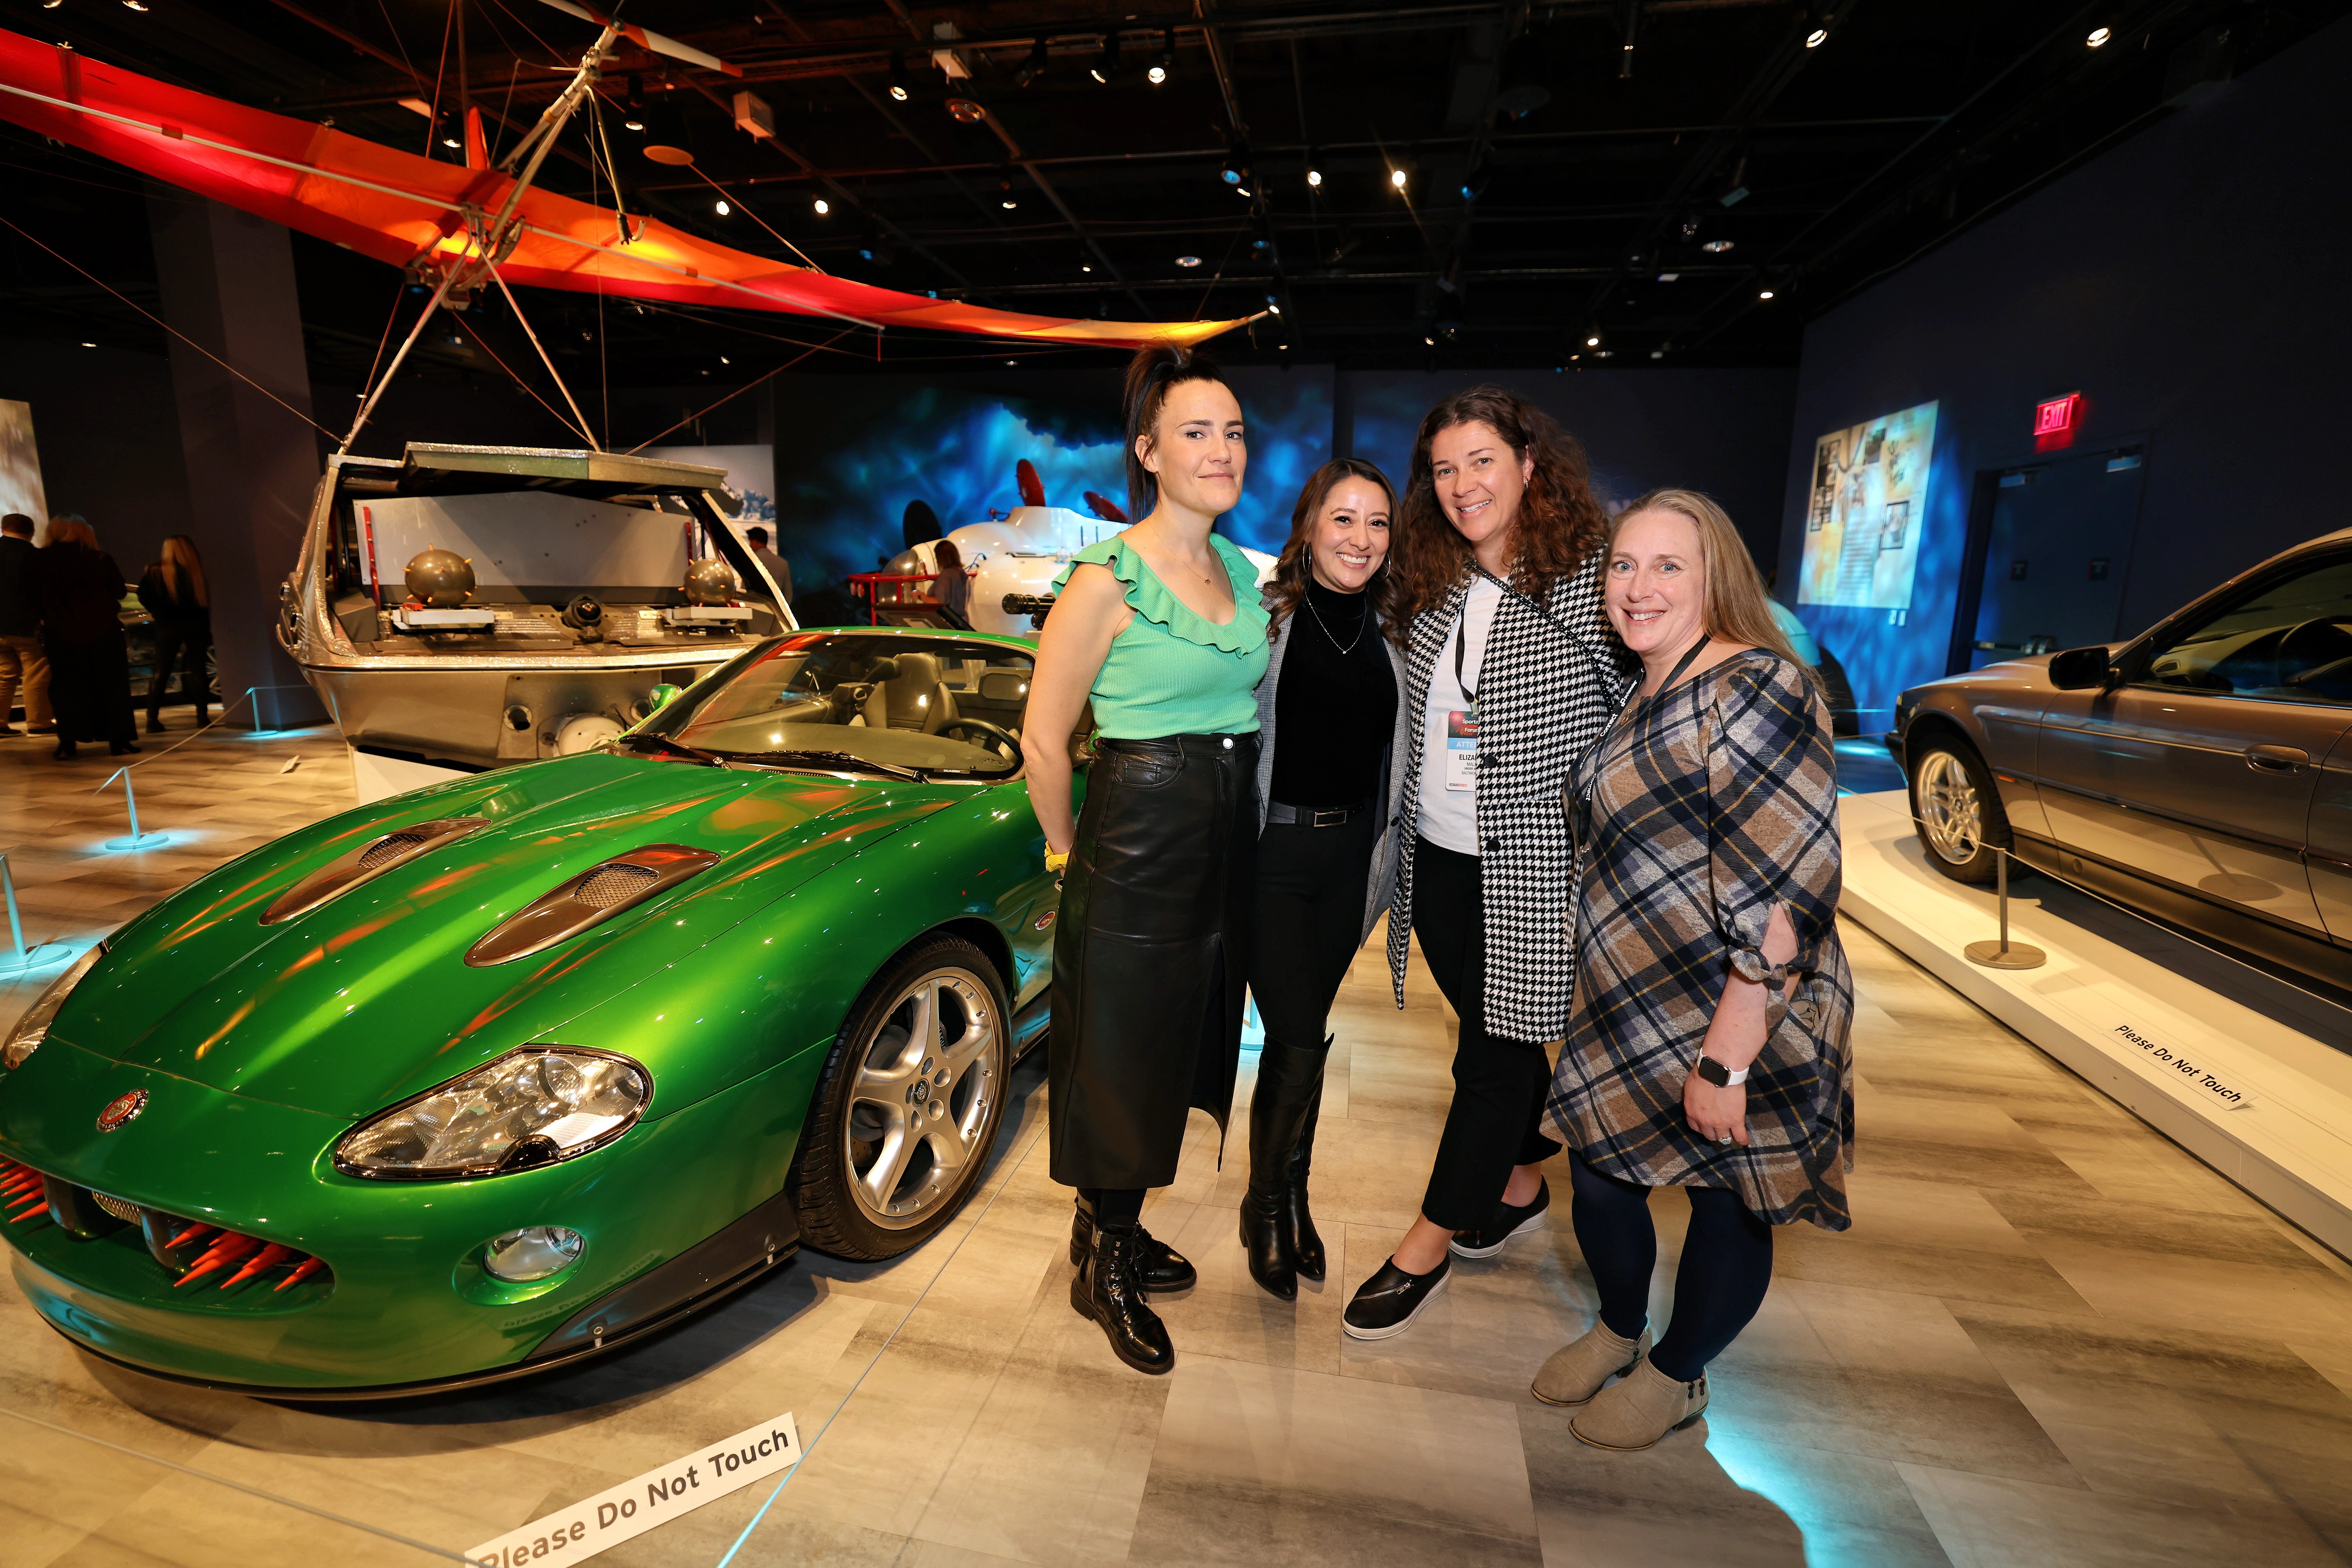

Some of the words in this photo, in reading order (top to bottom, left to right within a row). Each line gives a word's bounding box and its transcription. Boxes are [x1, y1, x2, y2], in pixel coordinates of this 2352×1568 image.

[2041, 401, 2067, 430] EXIT
[1600, 713, 1618, 737] Connect
[1585, 773, 1597, 801] Connect
[2115, 1025, 2154, 1050] Please
[2153, 1048, 2173, 1061] Do
[2171, 1059, 2202, 1077] Not
[2199, 1074, 2242, 1102] Touch
[597, 1499, 637, 1530] Do
[648, 1465, 700, 1507] Not
[708, 1429, 789, 1478] Touch
